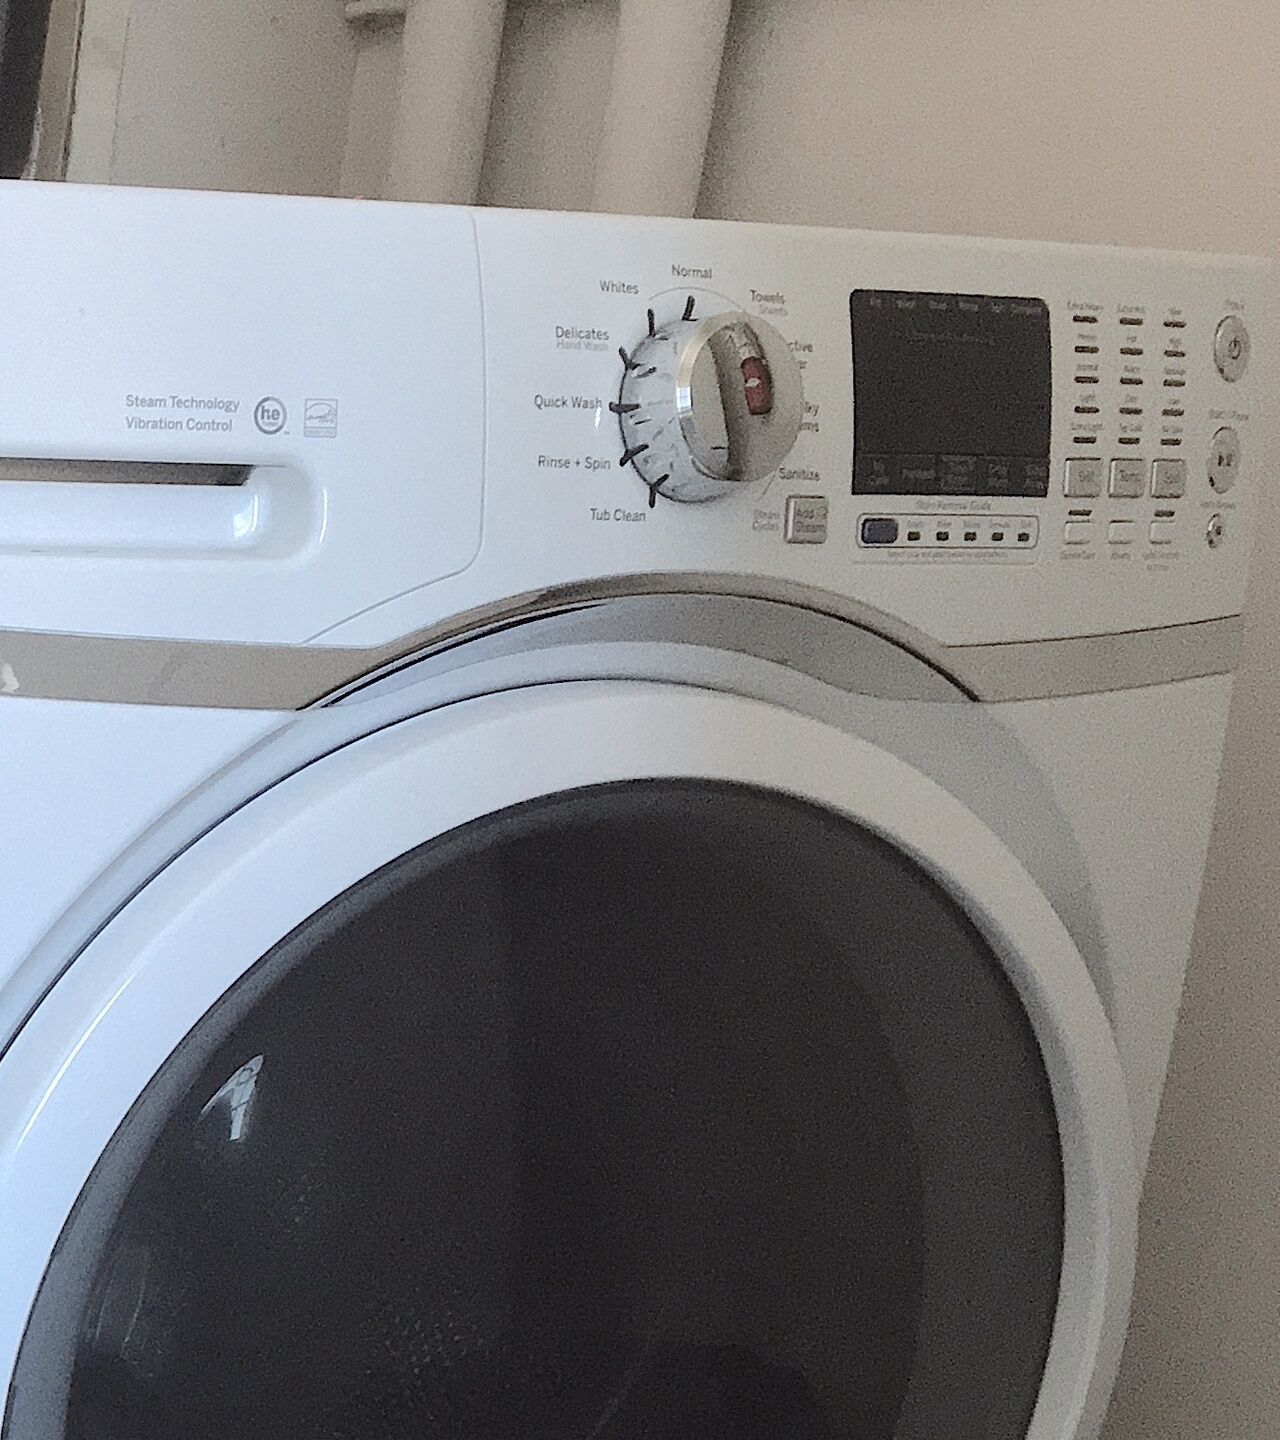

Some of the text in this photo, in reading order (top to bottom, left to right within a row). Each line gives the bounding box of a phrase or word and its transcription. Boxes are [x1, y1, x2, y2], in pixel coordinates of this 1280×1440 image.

[671, 264, 712, 279] Normal
[599, 280, 639, 295] Whites
[555, 326, 610, 341] Delicates
[790, 342, 814, 354] ctive
[125, 394, 241, 413] Steam Technology
[534, 394, 603, 411] Quick Wash
[260, 405, 281, 421] he
[125, 416, 233, 433] Vibration Control
[538, 455, 571, 469] Rinse
[584, 456, 611, 472] Spin
[590, 508, 646, 522] Tub Clean
